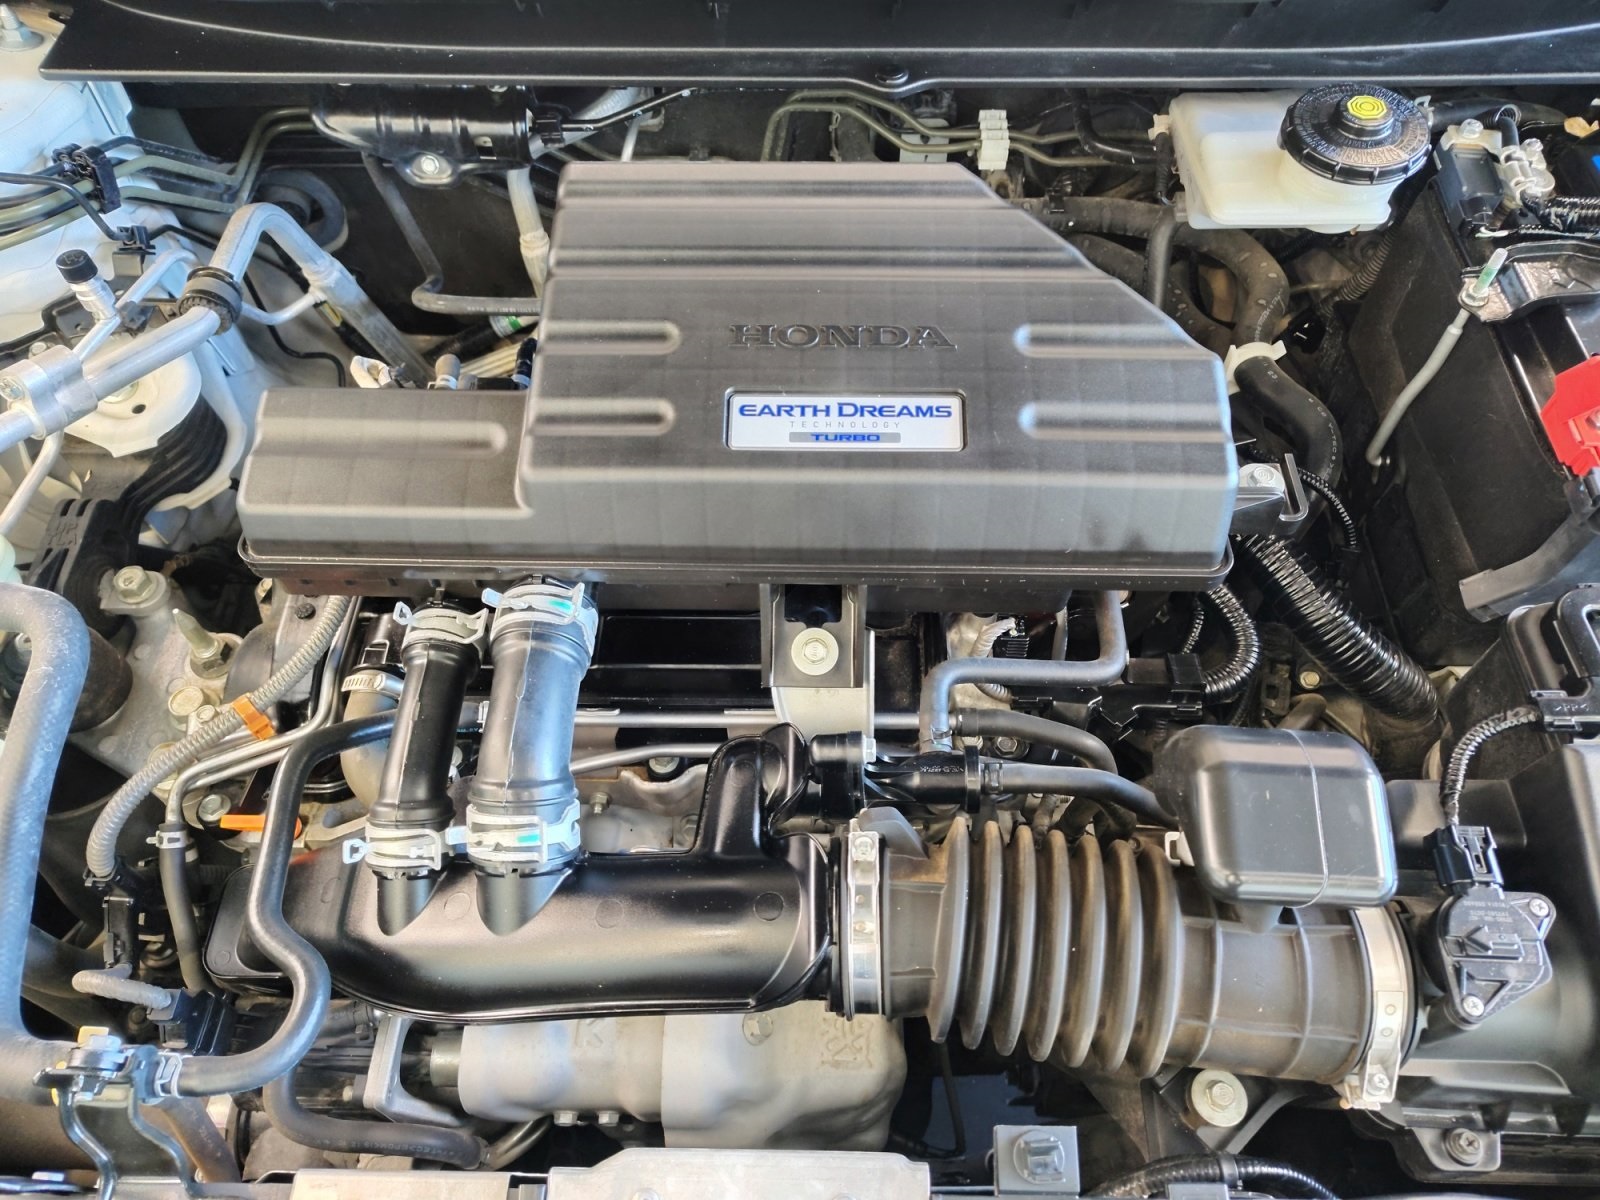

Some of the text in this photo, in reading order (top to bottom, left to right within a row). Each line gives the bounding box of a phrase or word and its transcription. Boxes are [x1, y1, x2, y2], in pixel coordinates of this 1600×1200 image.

[729, 324, 957, 350] HONDA
[739, 402, 952, 418] EARTH DREAMS
[790, 420, 900, 428] TECHNOLOGY
[810, 433, 880, 441] TURBO
